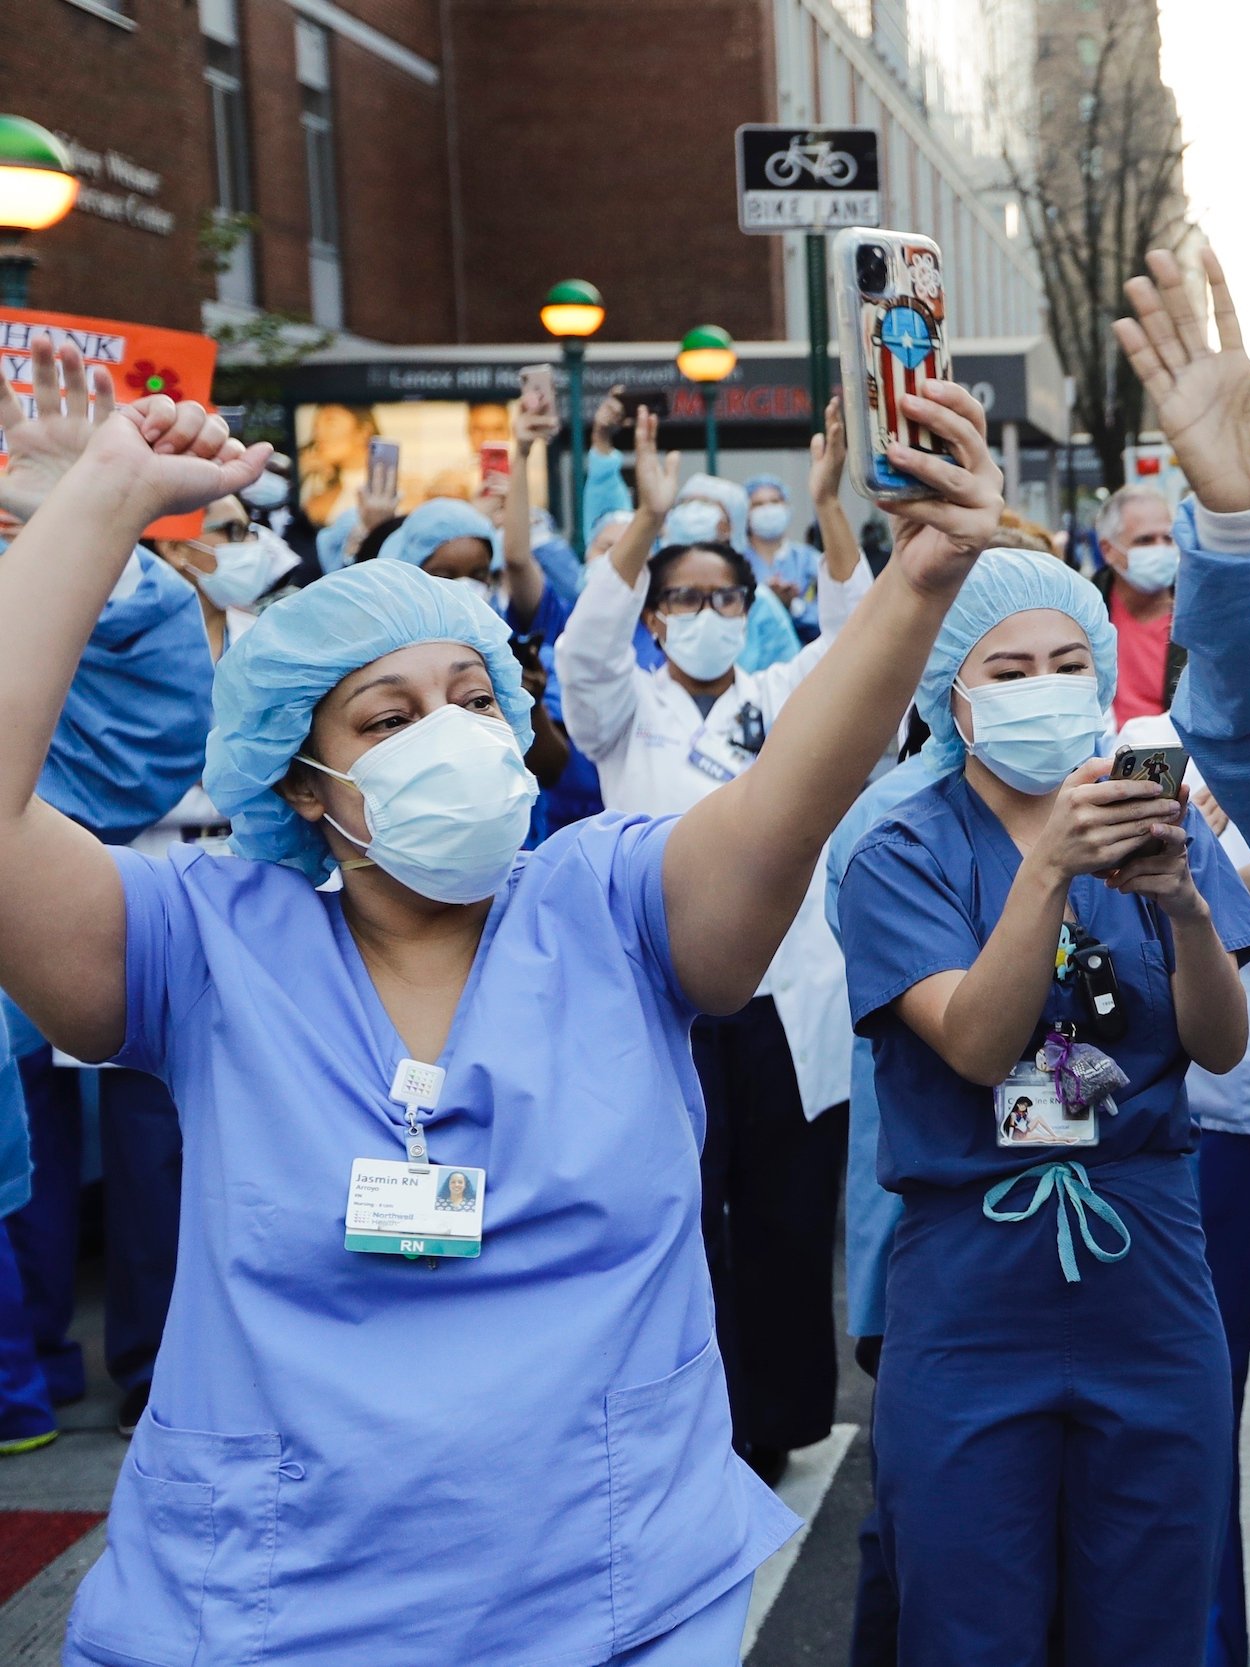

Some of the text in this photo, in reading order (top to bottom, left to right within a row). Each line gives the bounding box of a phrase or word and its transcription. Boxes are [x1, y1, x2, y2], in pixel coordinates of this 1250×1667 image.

[748, 197, 801, 221] BIKE
[0, 322, 119, 364] HNK
[456, 367, 493, 389] Hill
[355, 1173, 419, 1187] Jasmin RN
[355, 1185, 380, 1193] Arroyo
[372, 1211, 415, 1220] Northwell
[400, 1239, 425, 1253] RN
